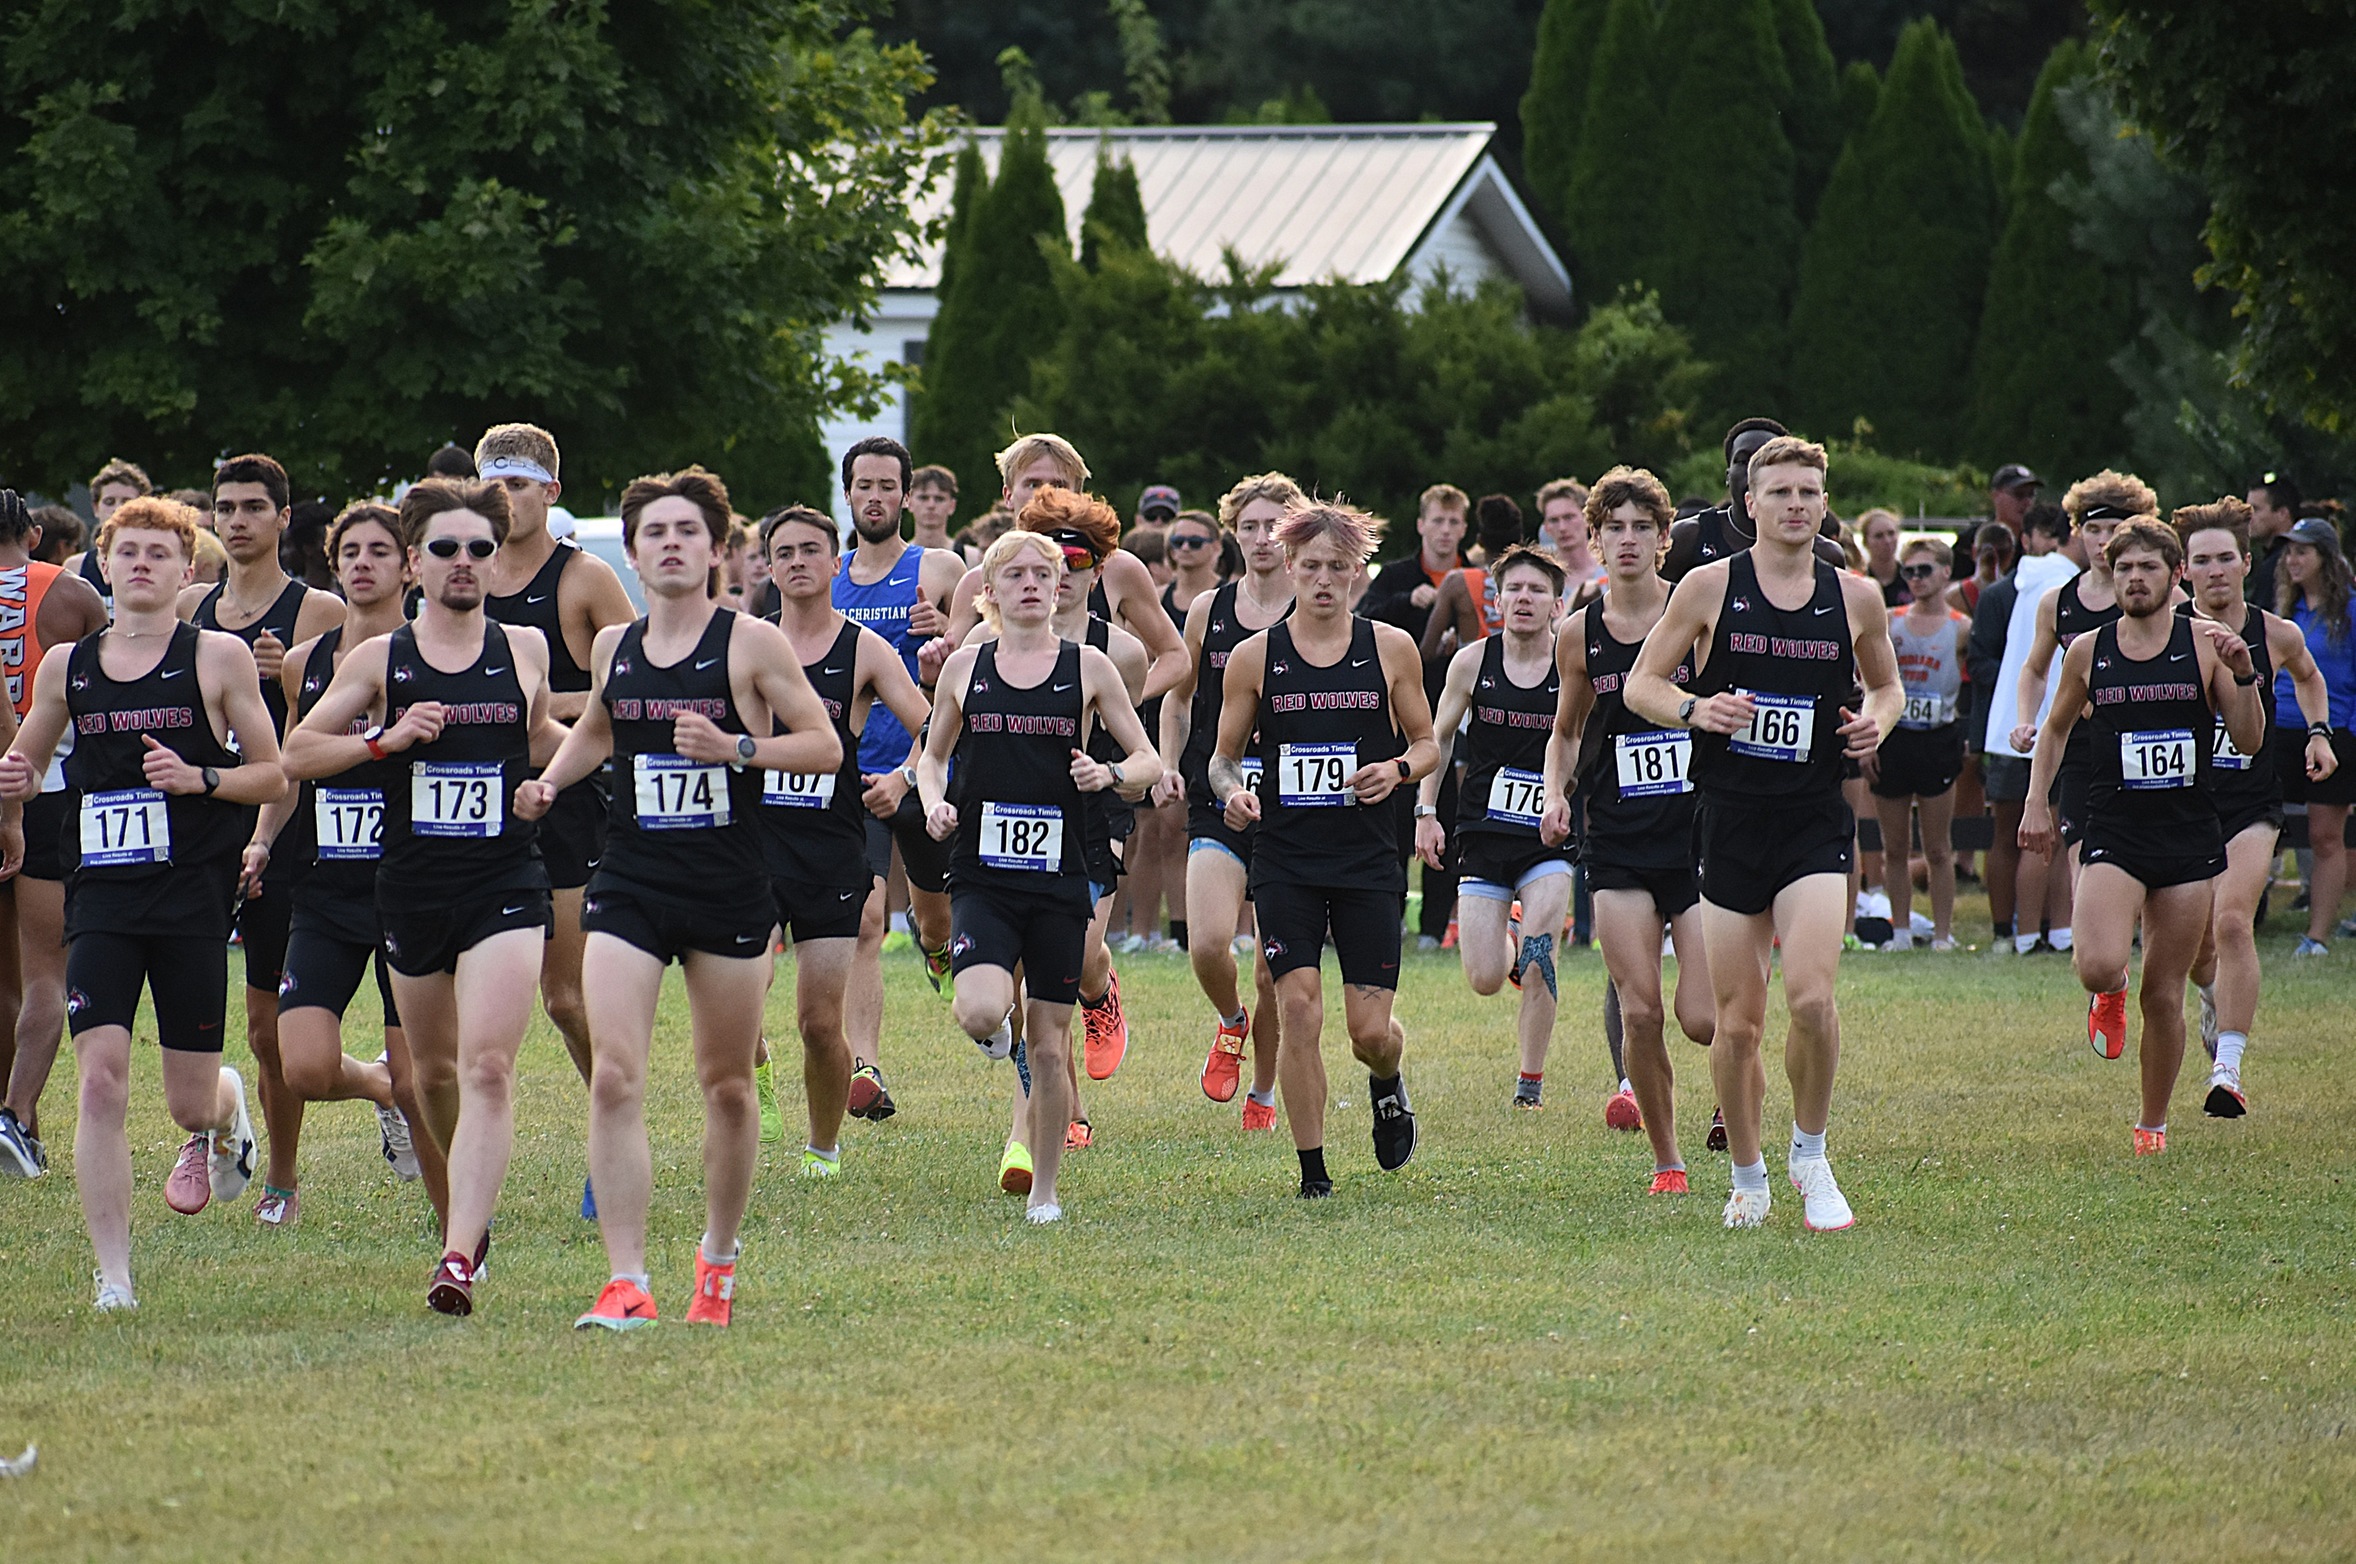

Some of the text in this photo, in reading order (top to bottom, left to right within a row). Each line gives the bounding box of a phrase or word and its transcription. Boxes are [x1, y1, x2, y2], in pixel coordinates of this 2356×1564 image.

[848, 606, 907, 620] CHRISTIAN
[1730, 632, 1840, 661] RED WOLVES
[1272, 691, 1380, 713] RED WOLVES
[1755, 695, 1814, 708] ossroads Timing
[2095, 683, 2198, 705] RED WOLVES
[77, 707, 193, 735] RED WOLVES
[969, 713, 1076, 737] RED WOLVES
[1478, 705, 1505, 725] RED
[1625, 731, 1689, 744] Crossroads Timing
[1750, 708, 1800, 746] 166
[2133, 731, 2193, 742] Crossroads Timing
[1291, 745, 1356, 753] Crossroads Timing
[2136, 743, 2185, 777] 164
[426, 765, 500, 775] Crossroads Timing
[1292, 757, 1344, 792] 179
[1629, 744, 1679, 782] 181
[1504, 769, 1539, 781] Crossroads
[94, 791, 164, 805] Crossroads Timing
[326, 792, 369, 800] Crossroads
[429, 780, 487, 820] 173
[650, 772, 714, 813] 174
[1504, 781, 1544, 815] 176
[995, 806, 1062, 818] Crossroads Timing
[95, 806, 151, 849] 171
[330, 805, 384, 844] 172
[996, 819, 1049, 856] 182
